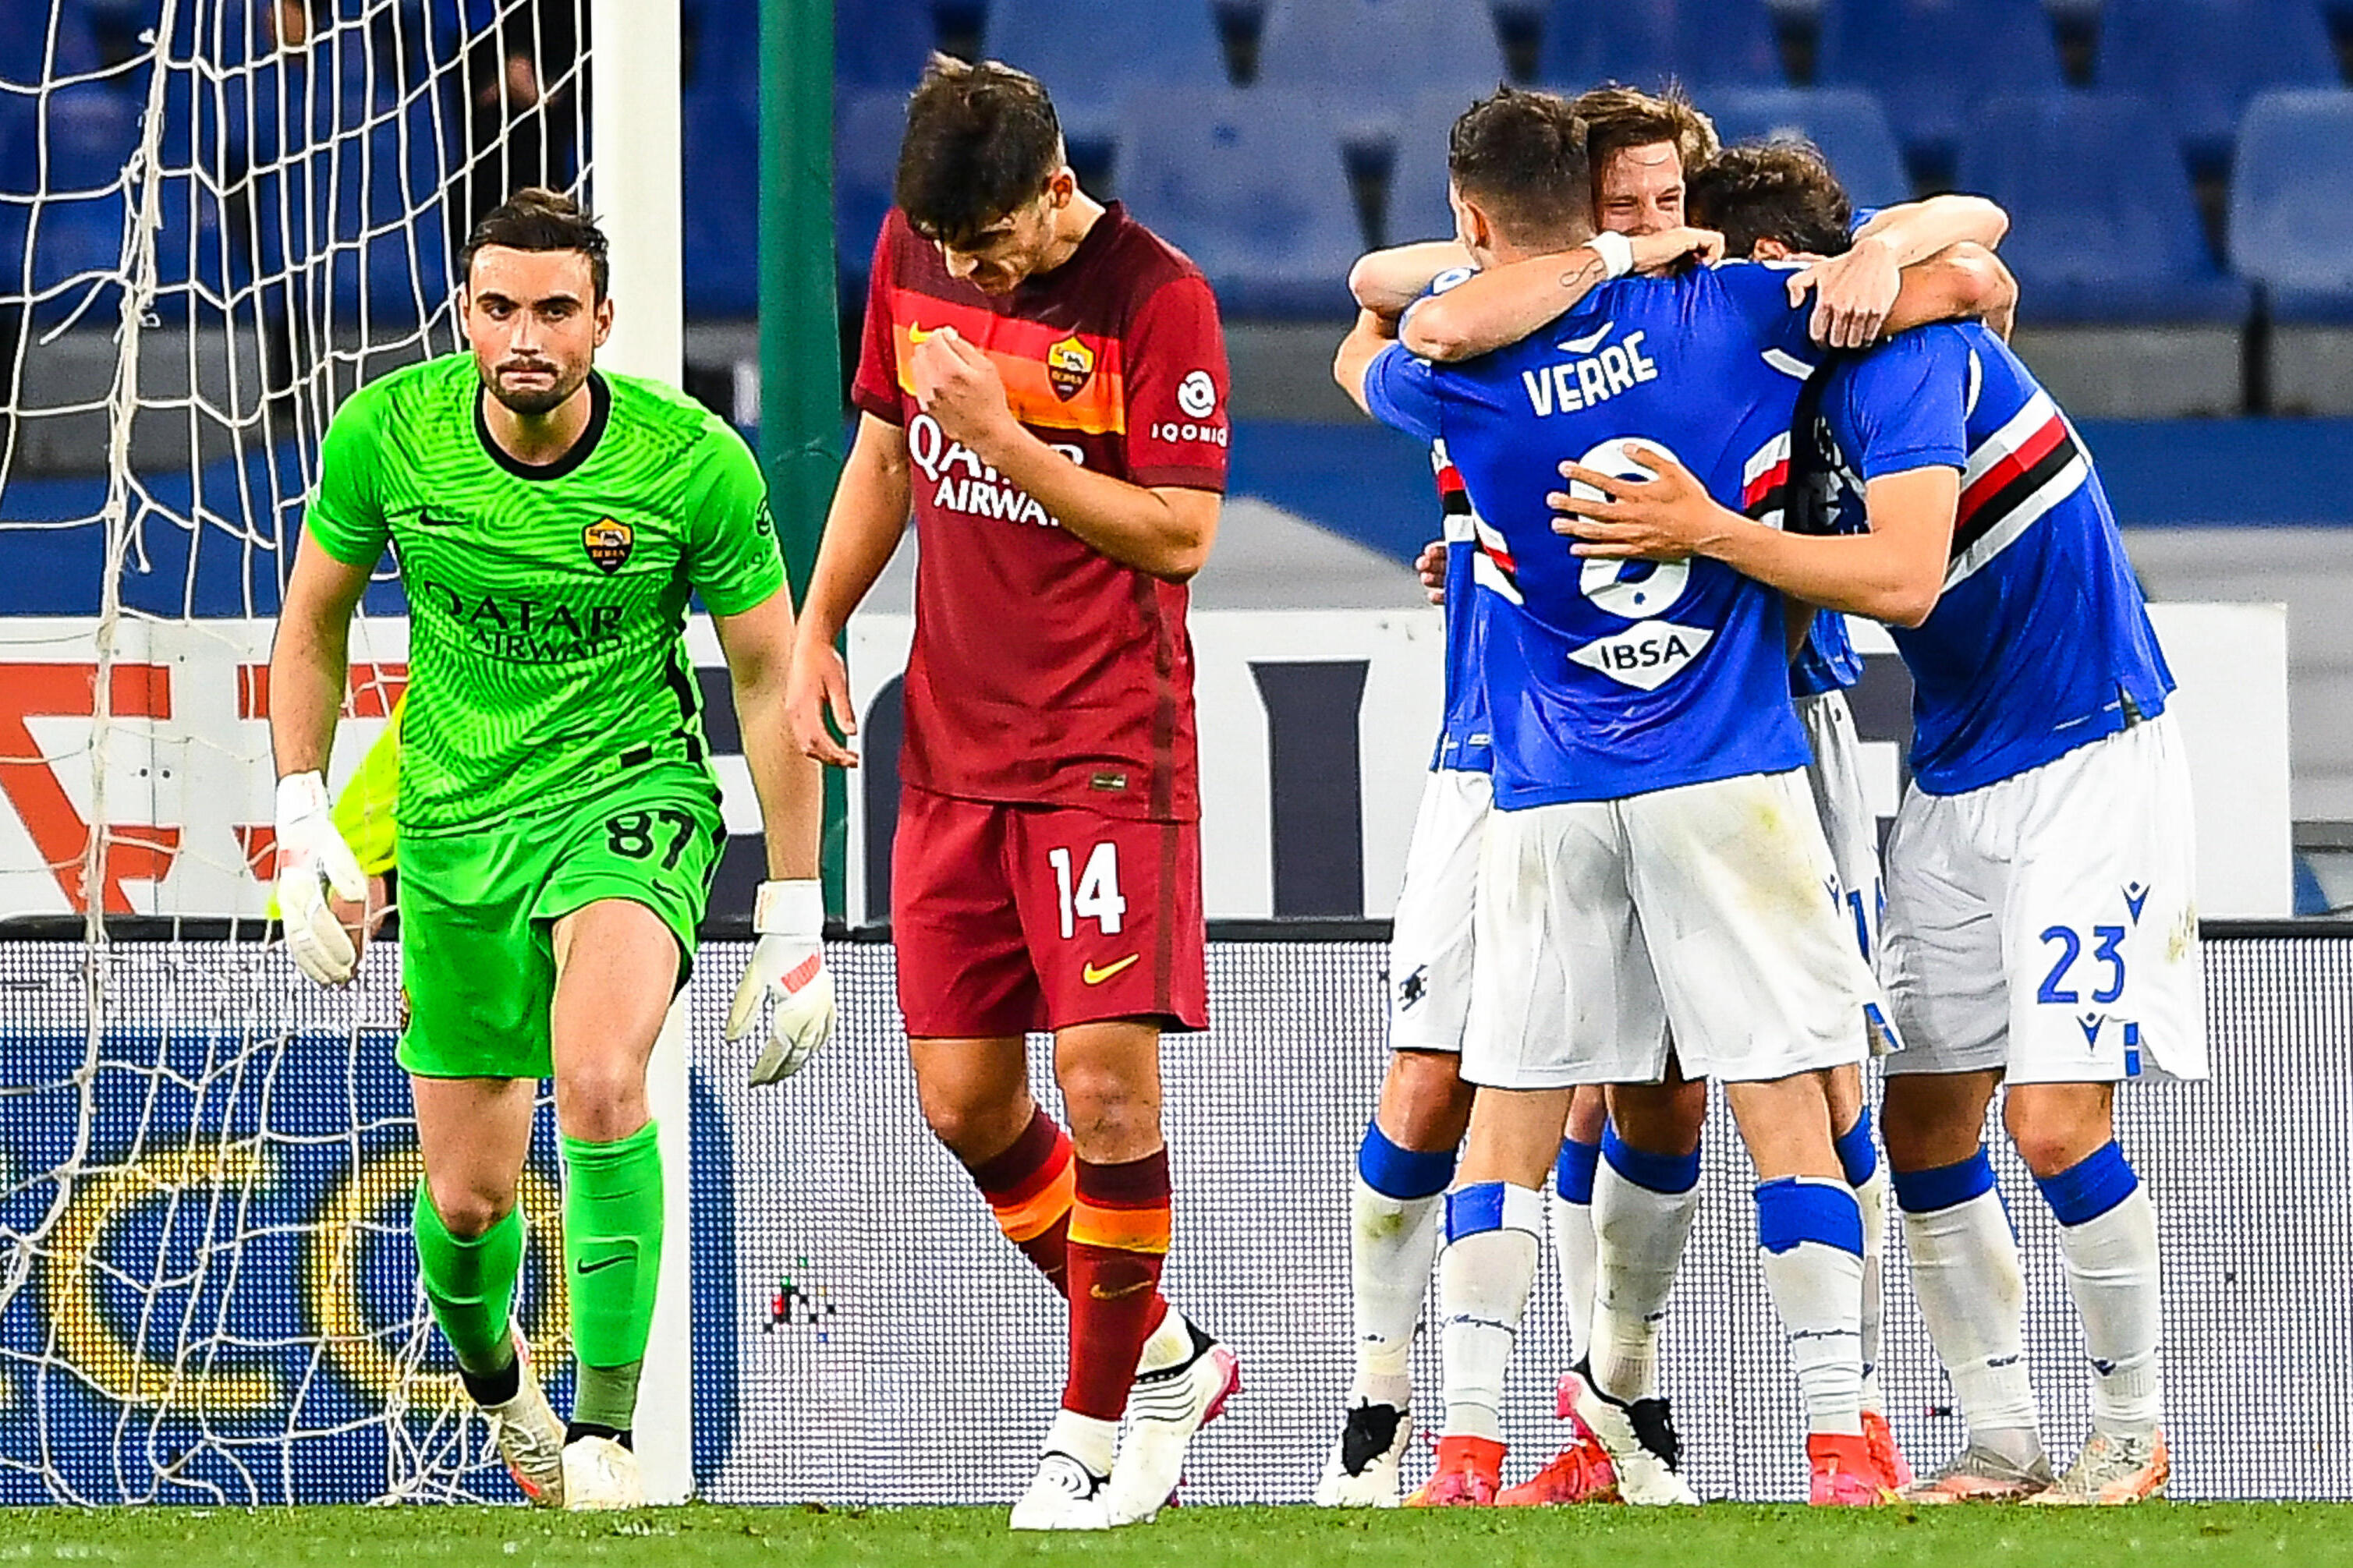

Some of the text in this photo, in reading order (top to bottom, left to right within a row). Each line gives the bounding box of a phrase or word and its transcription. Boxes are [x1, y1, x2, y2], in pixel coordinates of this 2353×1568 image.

[1522, 330, 1658, 416] VERRE
[1151, 423, 1228, 448] IQONIQ
[934, 476, 1059, 527] AIRWA
[423, 579, 623, 639] QATAR
[1600, 634, 1692, 671] IBSA
[605, 809, 694, 872] 87
[1048, 841, 1127, 939] 14
[2036, 924, 2126, 1005] 23
